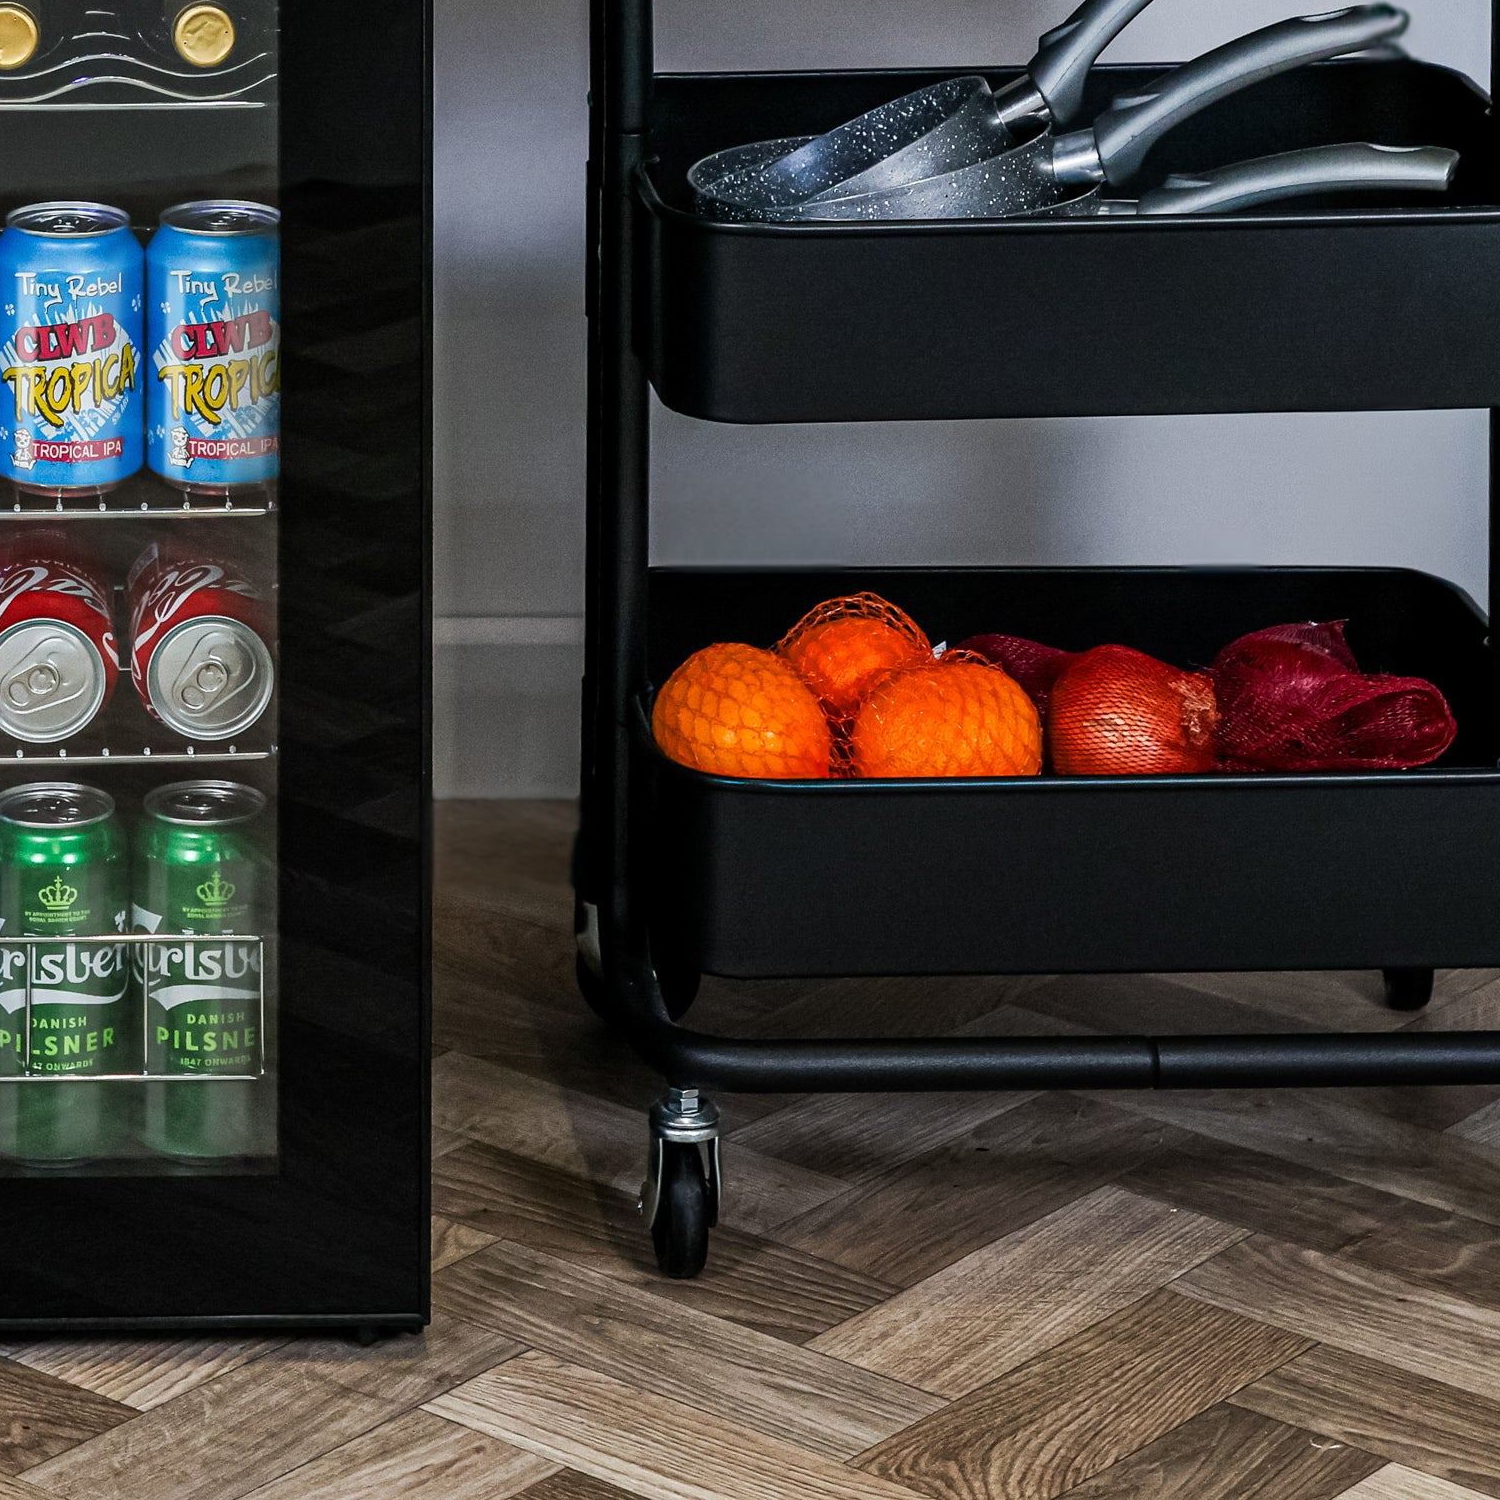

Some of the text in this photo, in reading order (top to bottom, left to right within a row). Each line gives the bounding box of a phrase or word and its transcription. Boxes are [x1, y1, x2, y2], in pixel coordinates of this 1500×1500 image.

[15, 272, 122, 310] Tiny Rebel
[170, 269, 278, 307] Tiny Rebel
[15, 312, 117, 363] CLWB
[171, 310, 273, 361] CLWB
[2, 342, 136, 428] TROPICA
[32, 440, 122, 459] TROPICAL IPA
[189, 440, 255, 456] TROPICAL
[187, 1012, 245, 1025] DANISH
[156, 1026, 256, 1051] PILSNE
